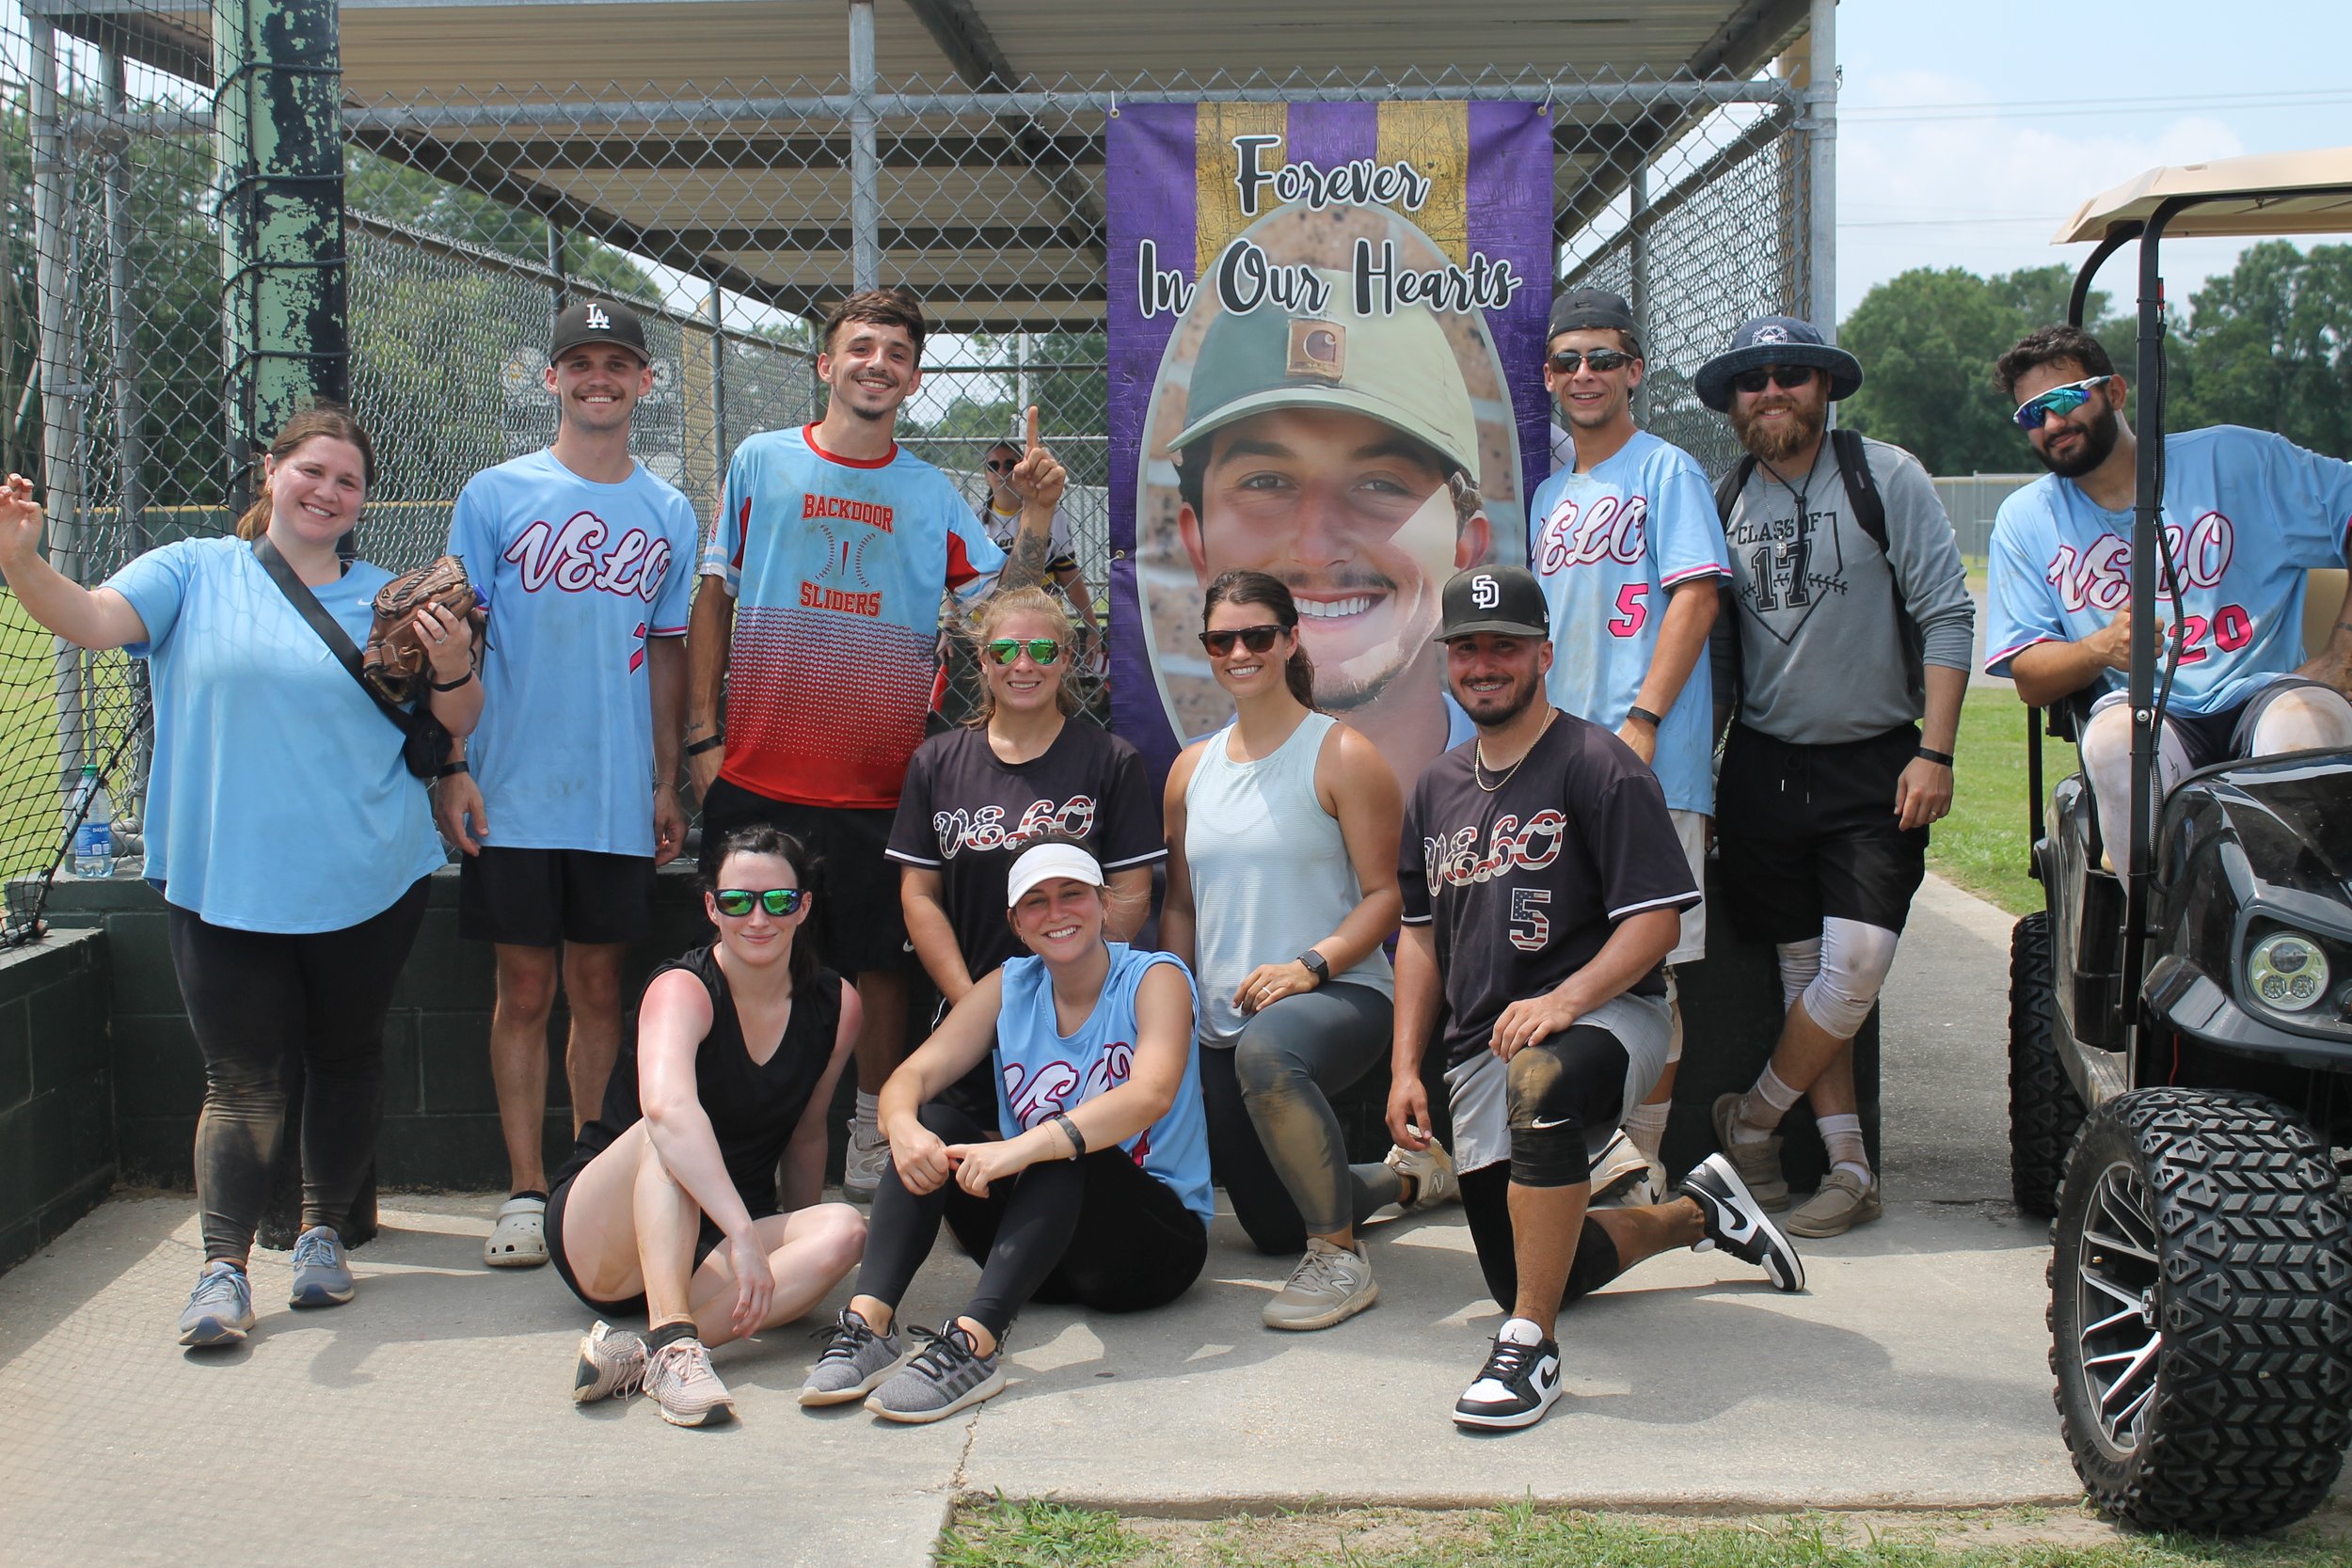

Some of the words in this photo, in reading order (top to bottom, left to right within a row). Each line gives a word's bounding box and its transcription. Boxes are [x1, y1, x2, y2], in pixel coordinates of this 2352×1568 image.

[1232, 135, 1431, 216] Forever
[1138, 239, 1196, 319] In
[1216, 237, 1332, 317] Our
[1352, 237, 1522, 319] Hearts
[586, 303, 611, 330] LA
[802, 492, 894, 534] BACKDOOR
[1532, 496, 1646, 576] ELO
[1737, 517, 1794, 546] CLASS
[800, 579, 882, 618] SLIDERS
[1471, 574, 1501, 610] SD
[1751, 539, 1812, 613] 17
[1607, 582, 1649, 639] 5
[2168, 603, 2253, 666] 20
[933, 795, 1097, 860] VELO
[1423, 808, 1567, 897] VELO
[1509, 888, 1551, 951] 5
